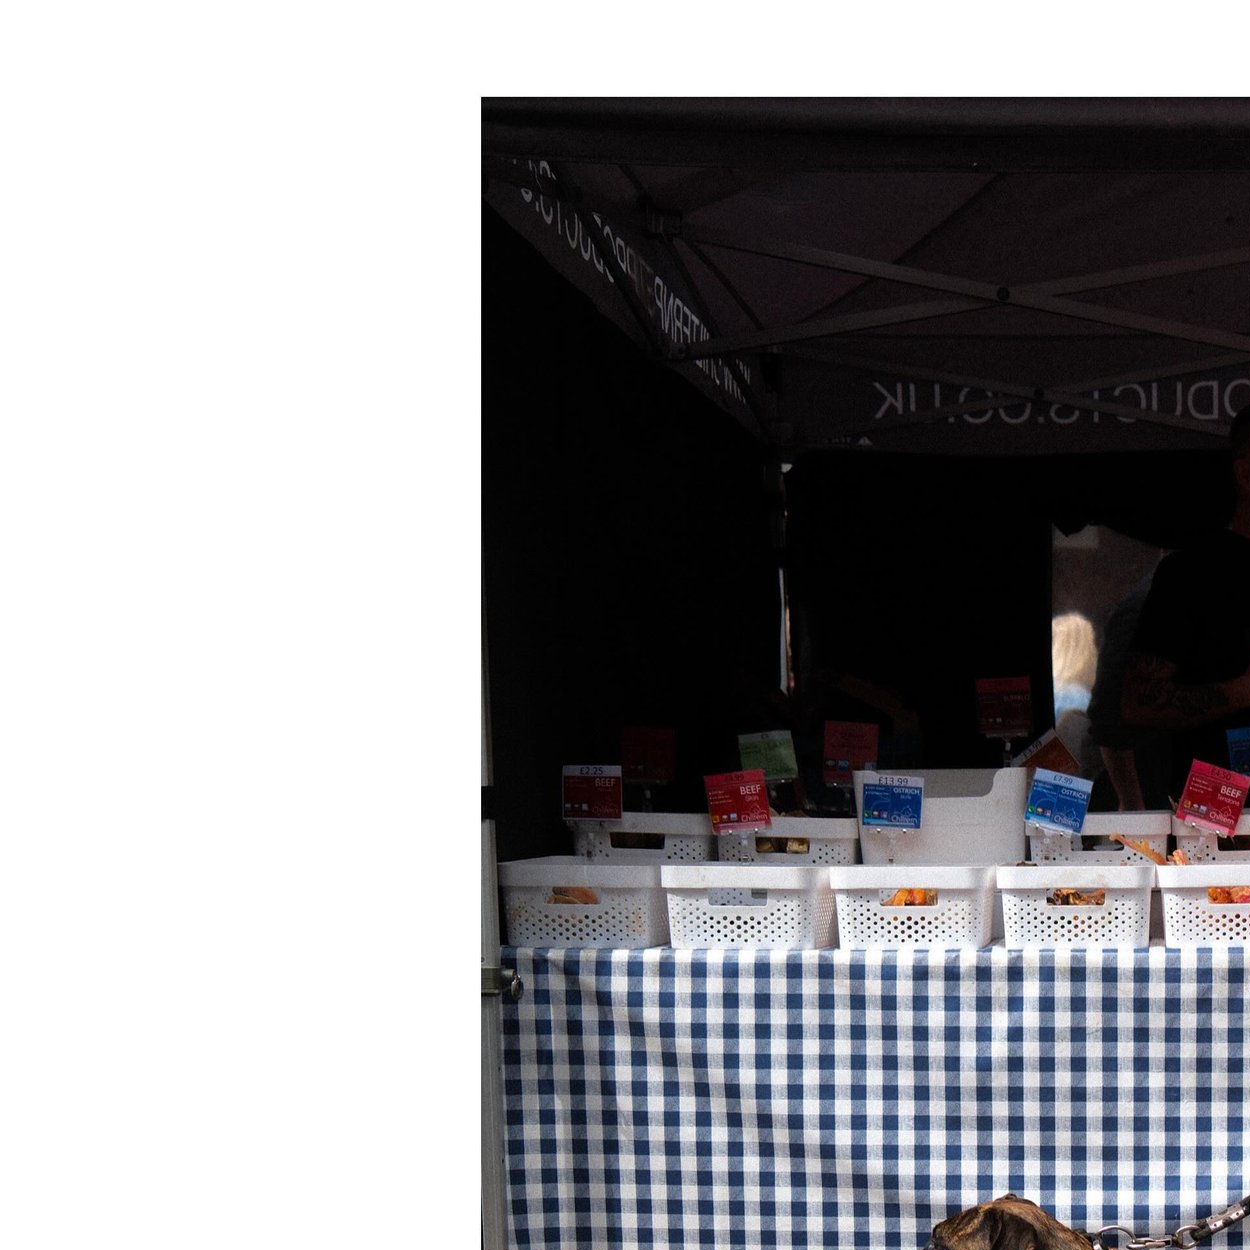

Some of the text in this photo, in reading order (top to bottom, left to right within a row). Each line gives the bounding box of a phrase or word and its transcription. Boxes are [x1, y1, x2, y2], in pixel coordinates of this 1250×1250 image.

[580, 766, 604, 775] £2.25
[595, 778, 616, 787] BEEF
[740, 784, 761, 795] BEEF
[893, 788, 920, 796] OSTRICH
[1061, 788, 1087, 800] OSTRICH
[1221, 785, 1242, 798] BEEF
